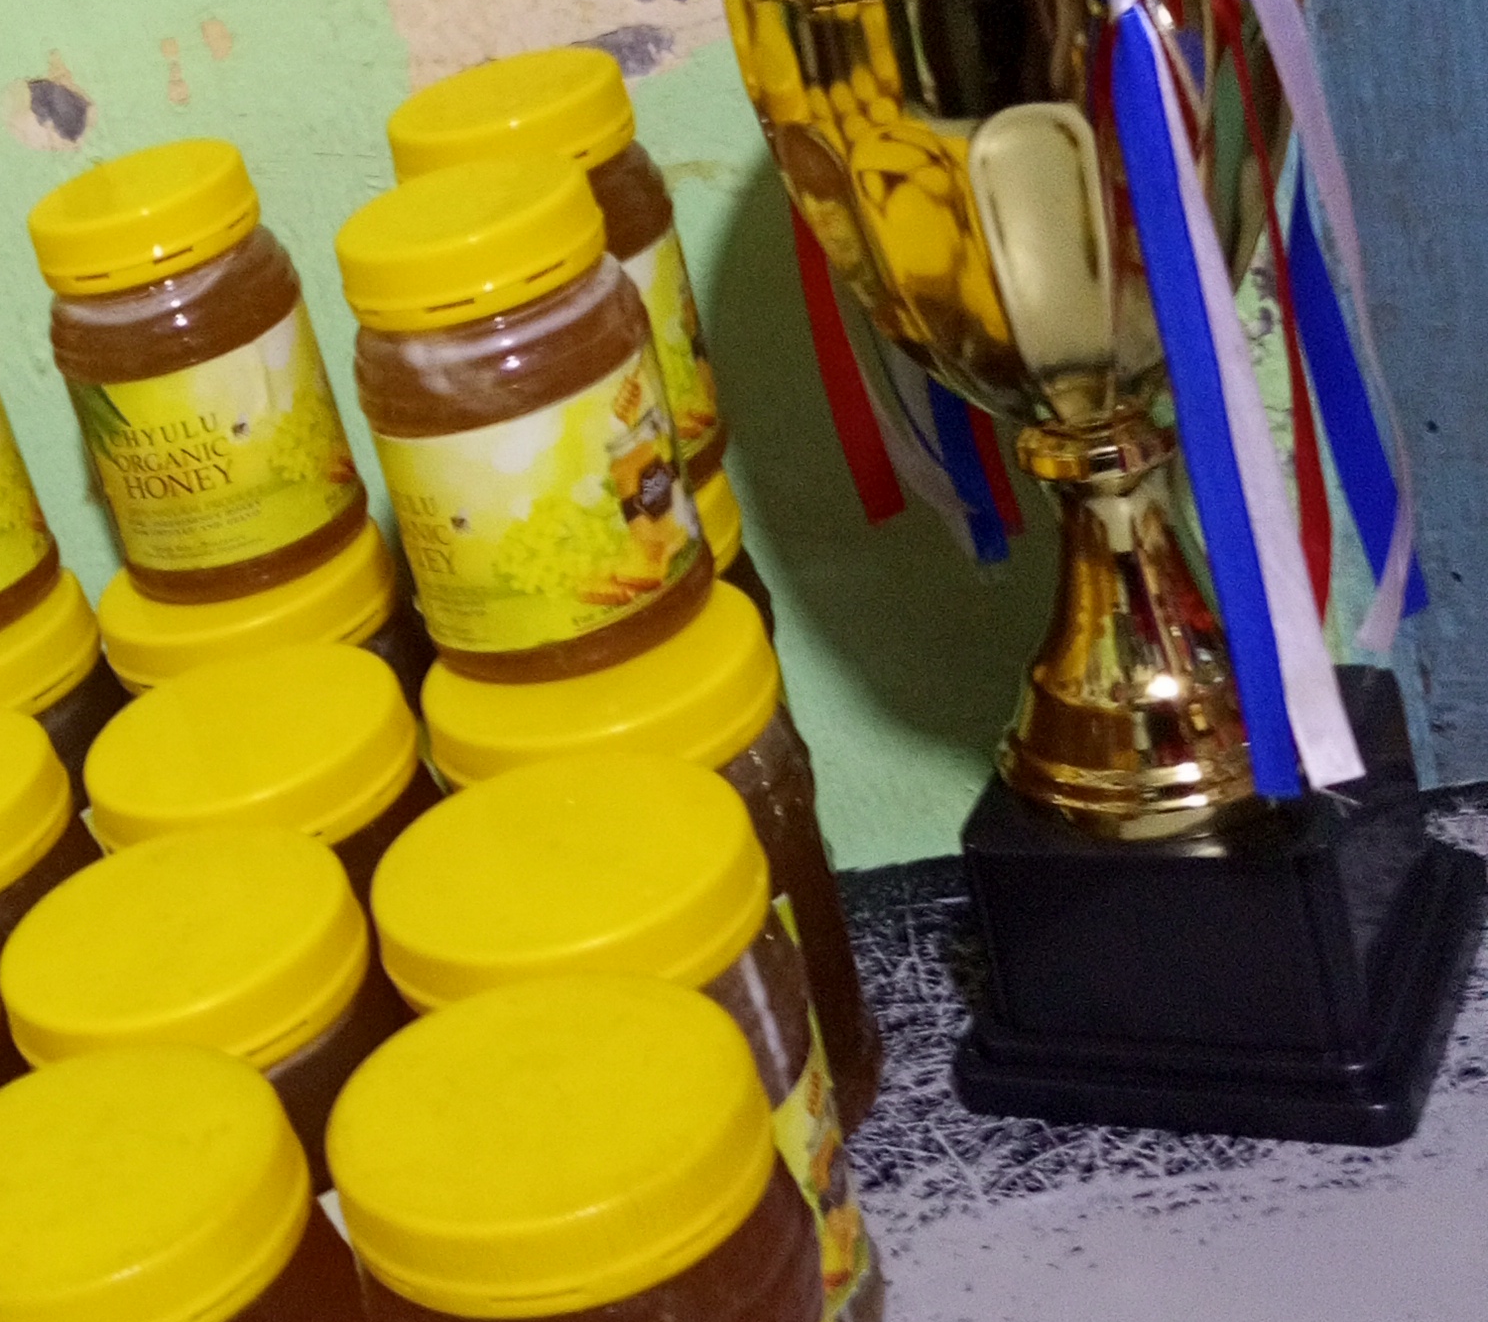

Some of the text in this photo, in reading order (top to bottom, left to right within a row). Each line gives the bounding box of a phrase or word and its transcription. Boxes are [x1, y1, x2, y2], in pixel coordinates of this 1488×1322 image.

[109, 413, 220, 448] CHYULU
[110, 436, 229, 474] ORGANIC
[122, 457, 234, 500] HONEY
